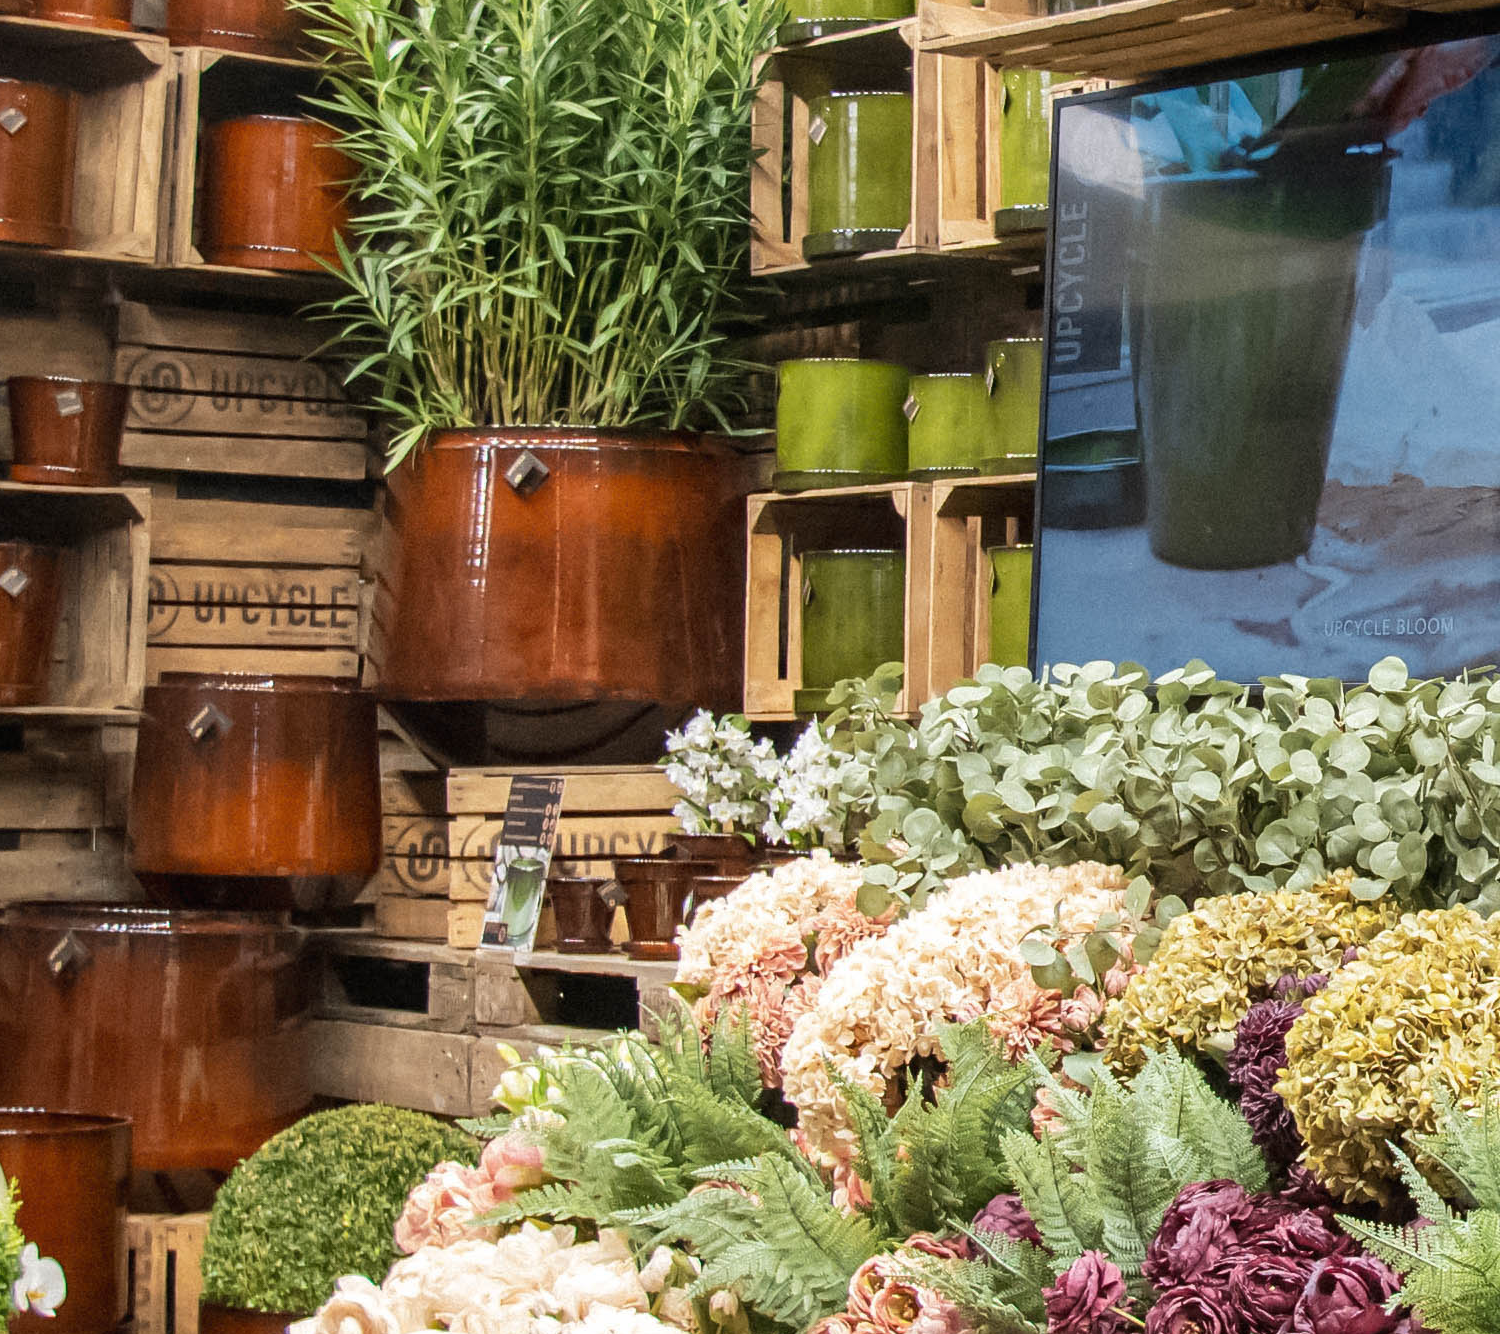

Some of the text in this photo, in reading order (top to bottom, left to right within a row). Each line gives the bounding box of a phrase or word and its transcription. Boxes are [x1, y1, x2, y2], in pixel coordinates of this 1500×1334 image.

[1055, 201, 1088, 363] UPCYCLE
[194, 581, 350, 629] UPCYCLE
[1323, 616, 1454, 637] UPCYCLE BLOOM
